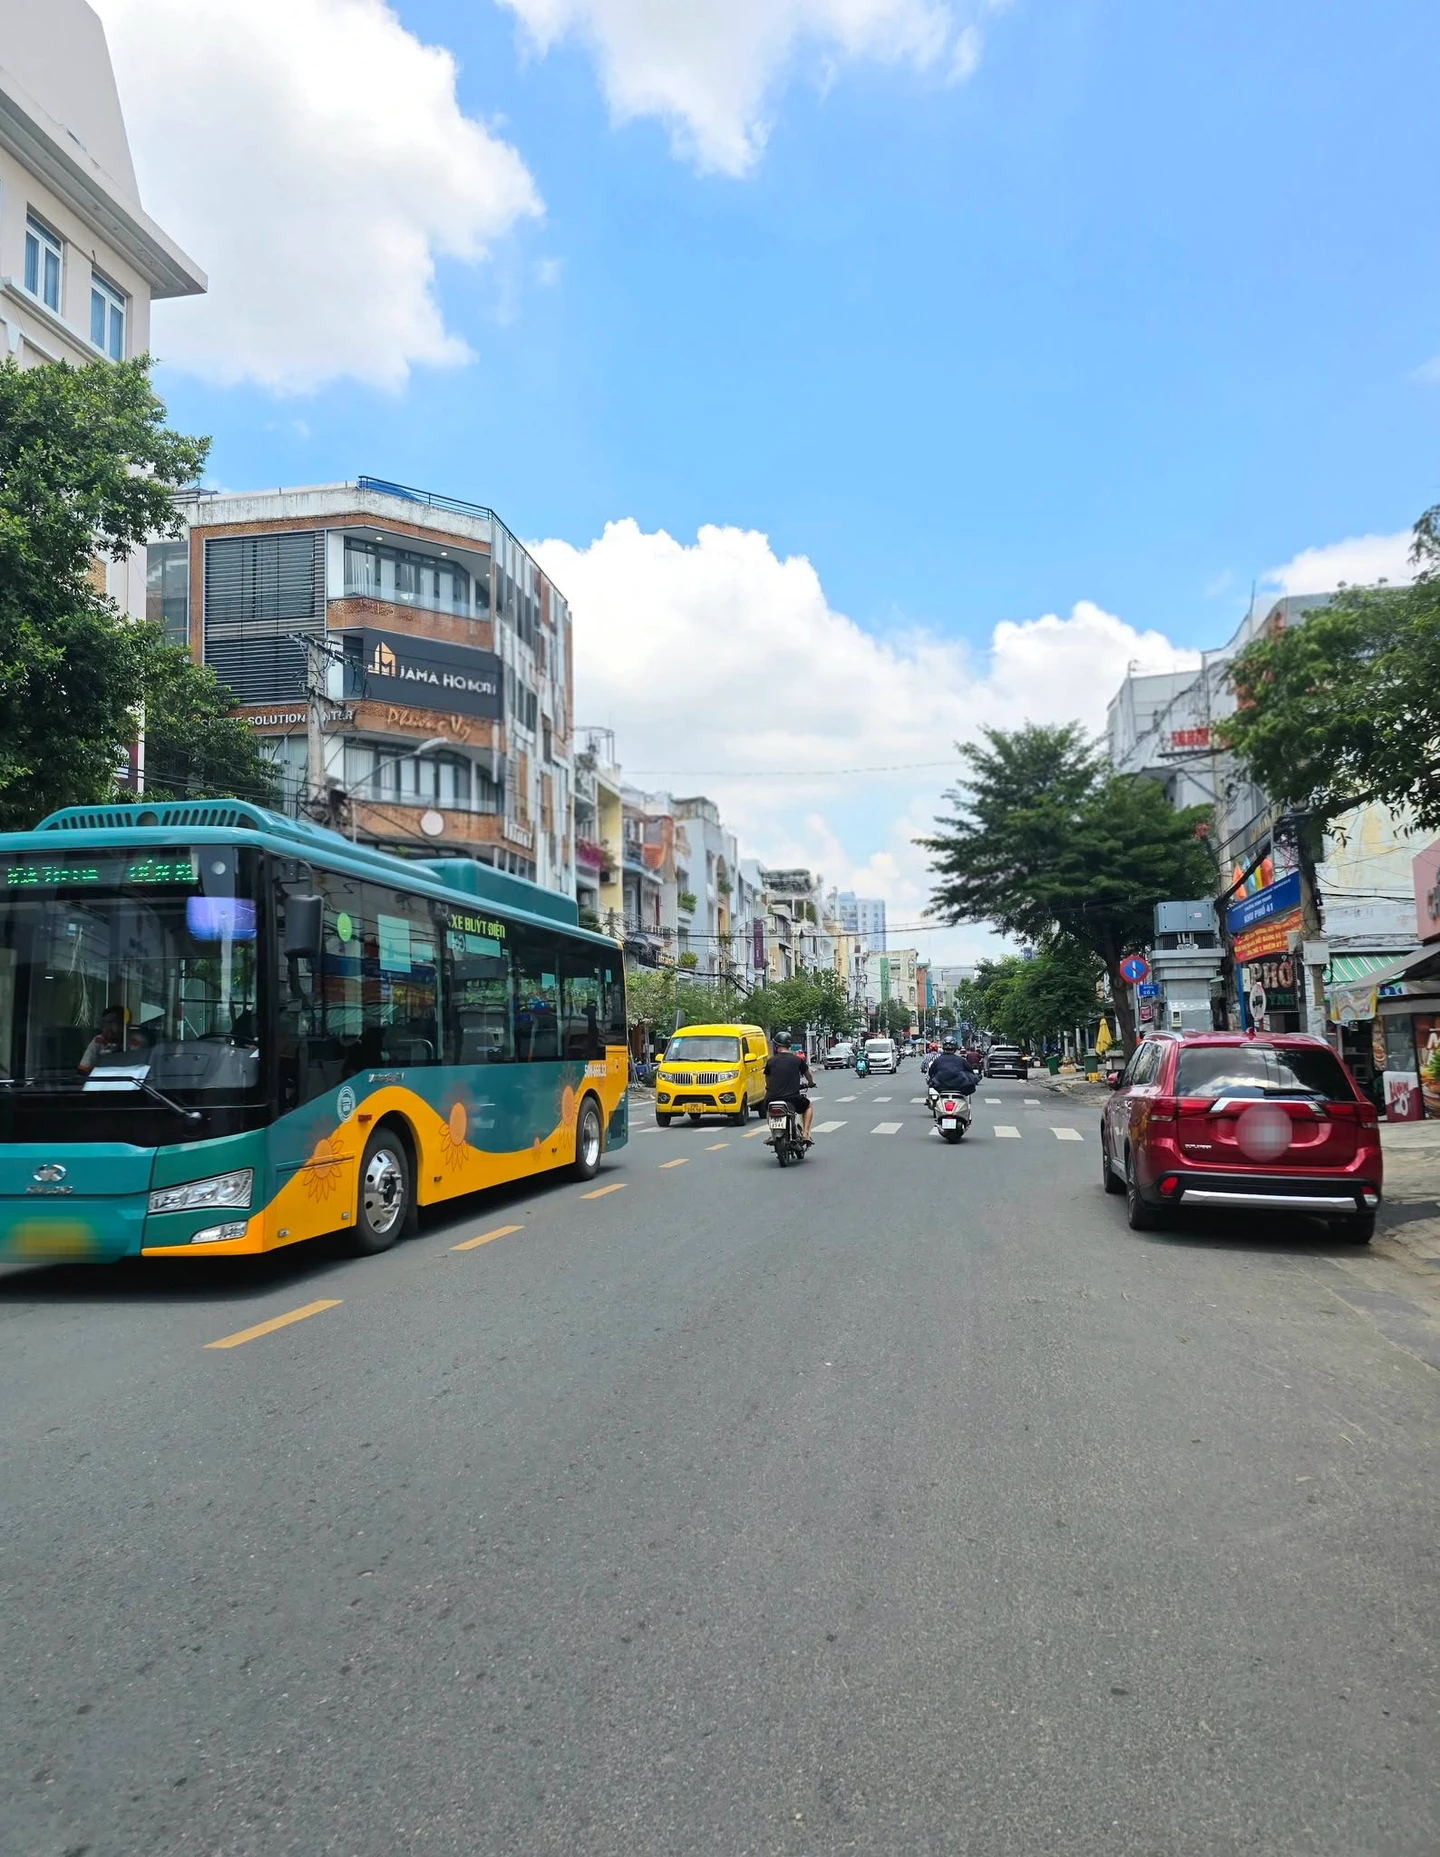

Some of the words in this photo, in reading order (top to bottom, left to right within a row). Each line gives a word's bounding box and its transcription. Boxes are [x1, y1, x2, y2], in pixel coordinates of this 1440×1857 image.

[247, 713, 306, 726] SOLUTION
[451, 913, 464, 930] XE
[464, 915, 487, 935] BUÝT
[1248, 954, 1294, 989] PHỞ
